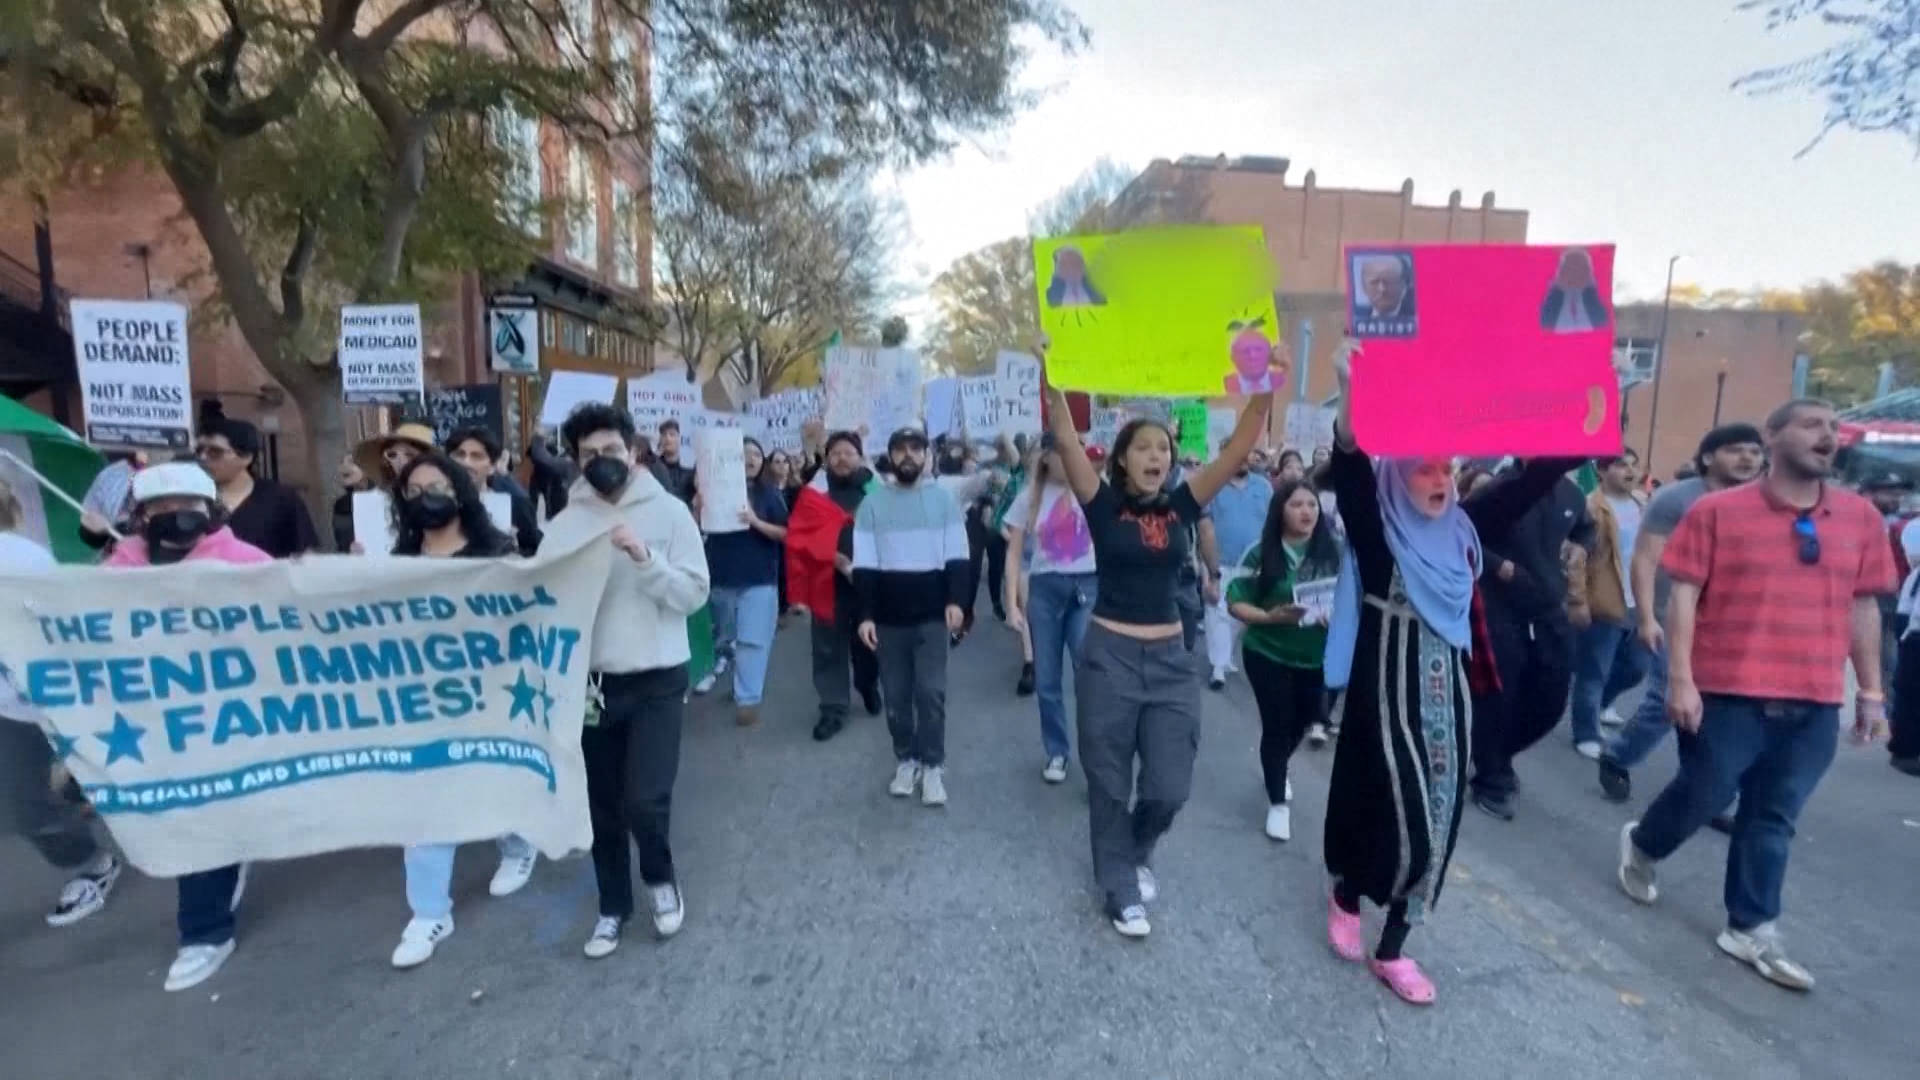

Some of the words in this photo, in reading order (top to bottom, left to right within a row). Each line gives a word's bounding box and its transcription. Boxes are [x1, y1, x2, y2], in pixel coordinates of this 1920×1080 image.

[97, 318, 178, 342] PEOPLE
[344, 316, 386, 326] MONEY
[392, 315, 415, 326] FOR
[84, 342, 181, 364] DEMAND:
[345, 335, 417, 349] MEDICAID
[348, 363, 372, 374] NOT
[378, 362, 415, 374] MASS
[90, 383, 124, 398] NOT
[132, 384, 182, 403] MASS
[91, 404, 184, 420] DEPORTATION!
[39, 611, 113, 644] THE
[130, 604, 304, 638] PEOPLE
[310, 595, 457, 634] UNITED
[465, 585, 557, 616] WILL
[26, 646, 257, 707] EFEND
[276, 622, 581, 687] IMMIGRANT
[163, 676, 486, 753] FAMILIES!
[242, 762, 290, 789] AND
[296, 750, 413, 775] LIBERATION
